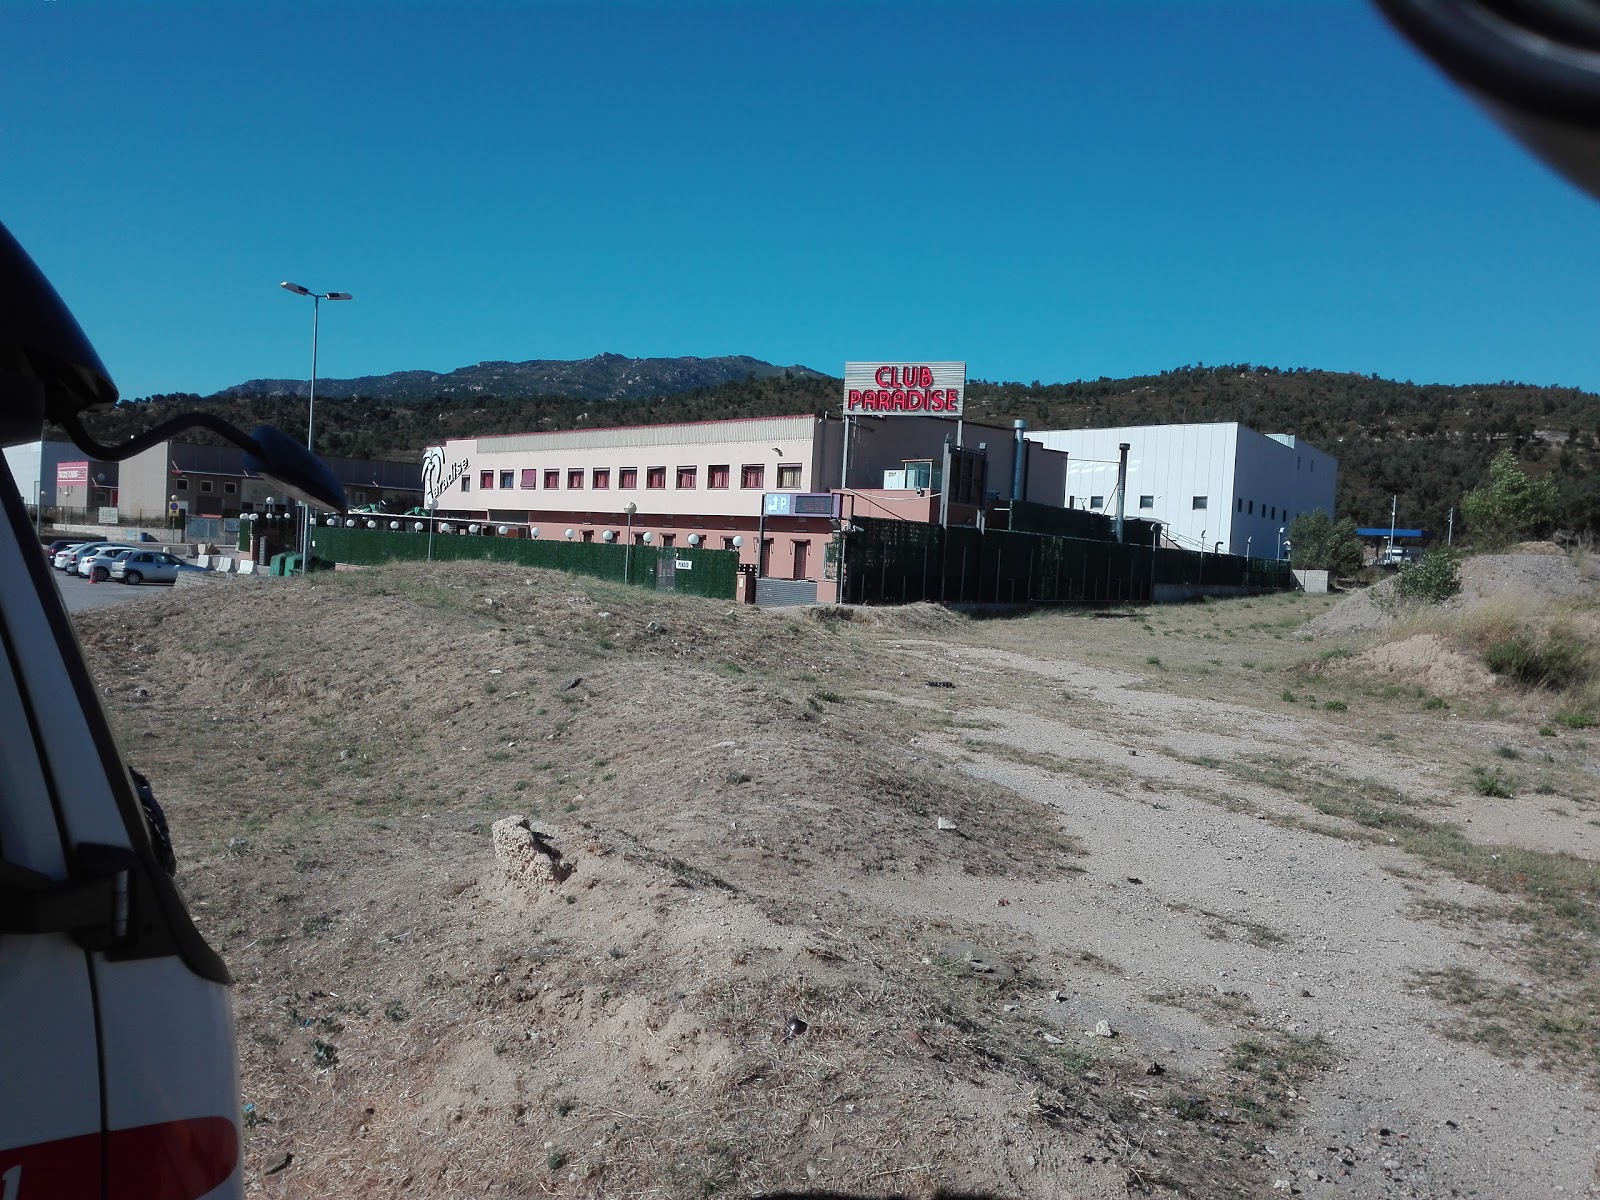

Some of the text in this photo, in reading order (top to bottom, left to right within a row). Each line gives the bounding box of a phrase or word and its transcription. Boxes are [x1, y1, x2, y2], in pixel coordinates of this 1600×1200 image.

[875, 366, 934, 389] CLUB
[847, 389, 959, 411] PARADISE
[780, 497, 787, 509] P
